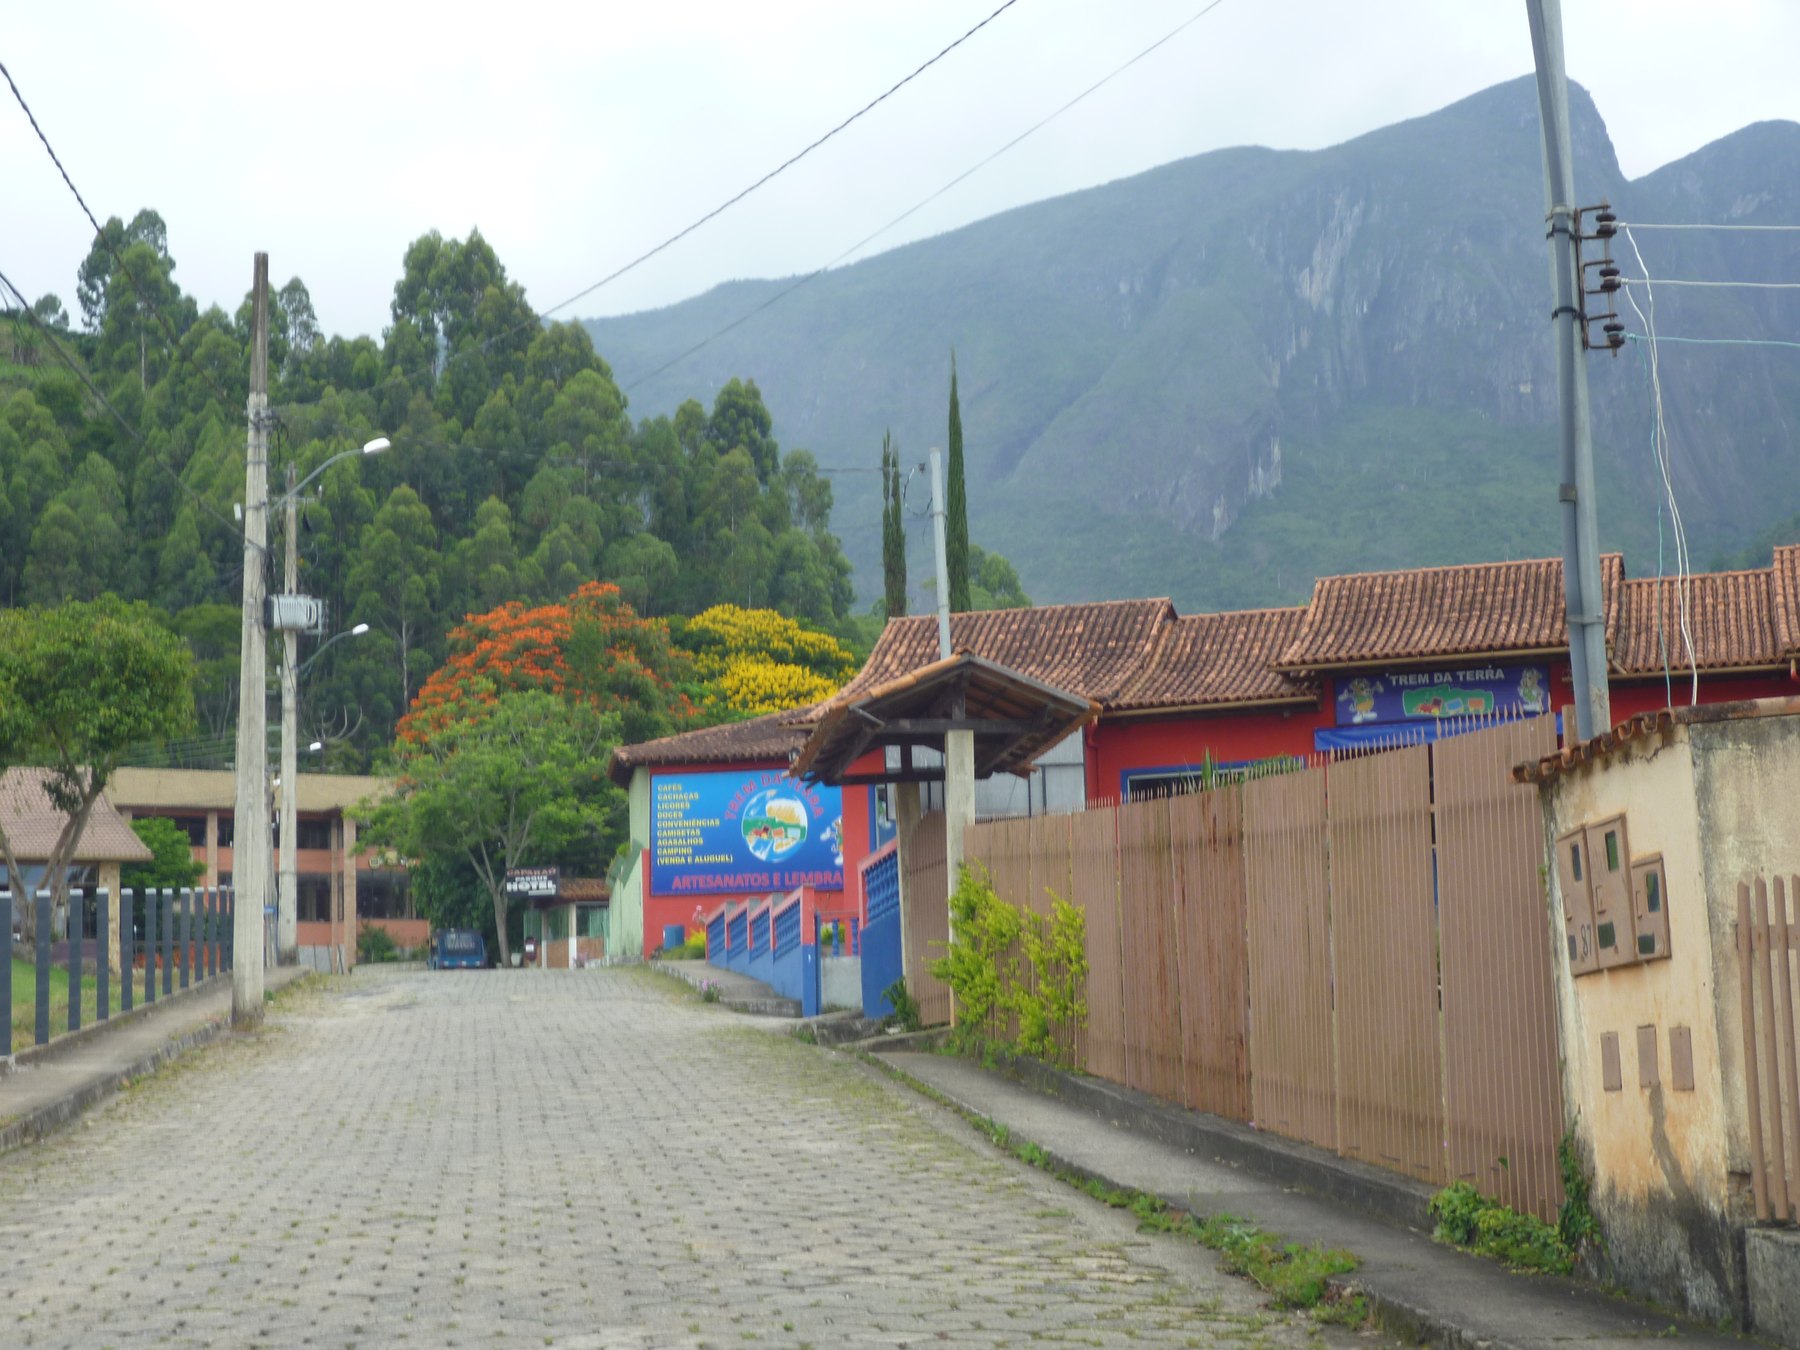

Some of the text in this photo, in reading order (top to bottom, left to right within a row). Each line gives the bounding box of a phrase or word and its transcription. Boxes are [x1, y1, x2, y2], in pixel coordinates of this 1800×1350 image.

[1390, 668, 1505, 686] TREM DA TERRA
[725, 773, 825, 819] TREM DA TERRA
[657, 801, 690, 810] LICORES
[657, 811, 683, 819] DOCES
[657, 828, 700, 838] CAMISETAS
[657, 837, 704, 847] AGASALHOS
[657, 847, 693, 856] CAMPING
[657, 854, 733, 867] (VENDA E ALUGUEL)
[506, 880, 552, 892] HOTEL
[672, 870, 843, 890] ARTESANATOS E LEMBRA
[1580, 924, 1592, 956] 87
